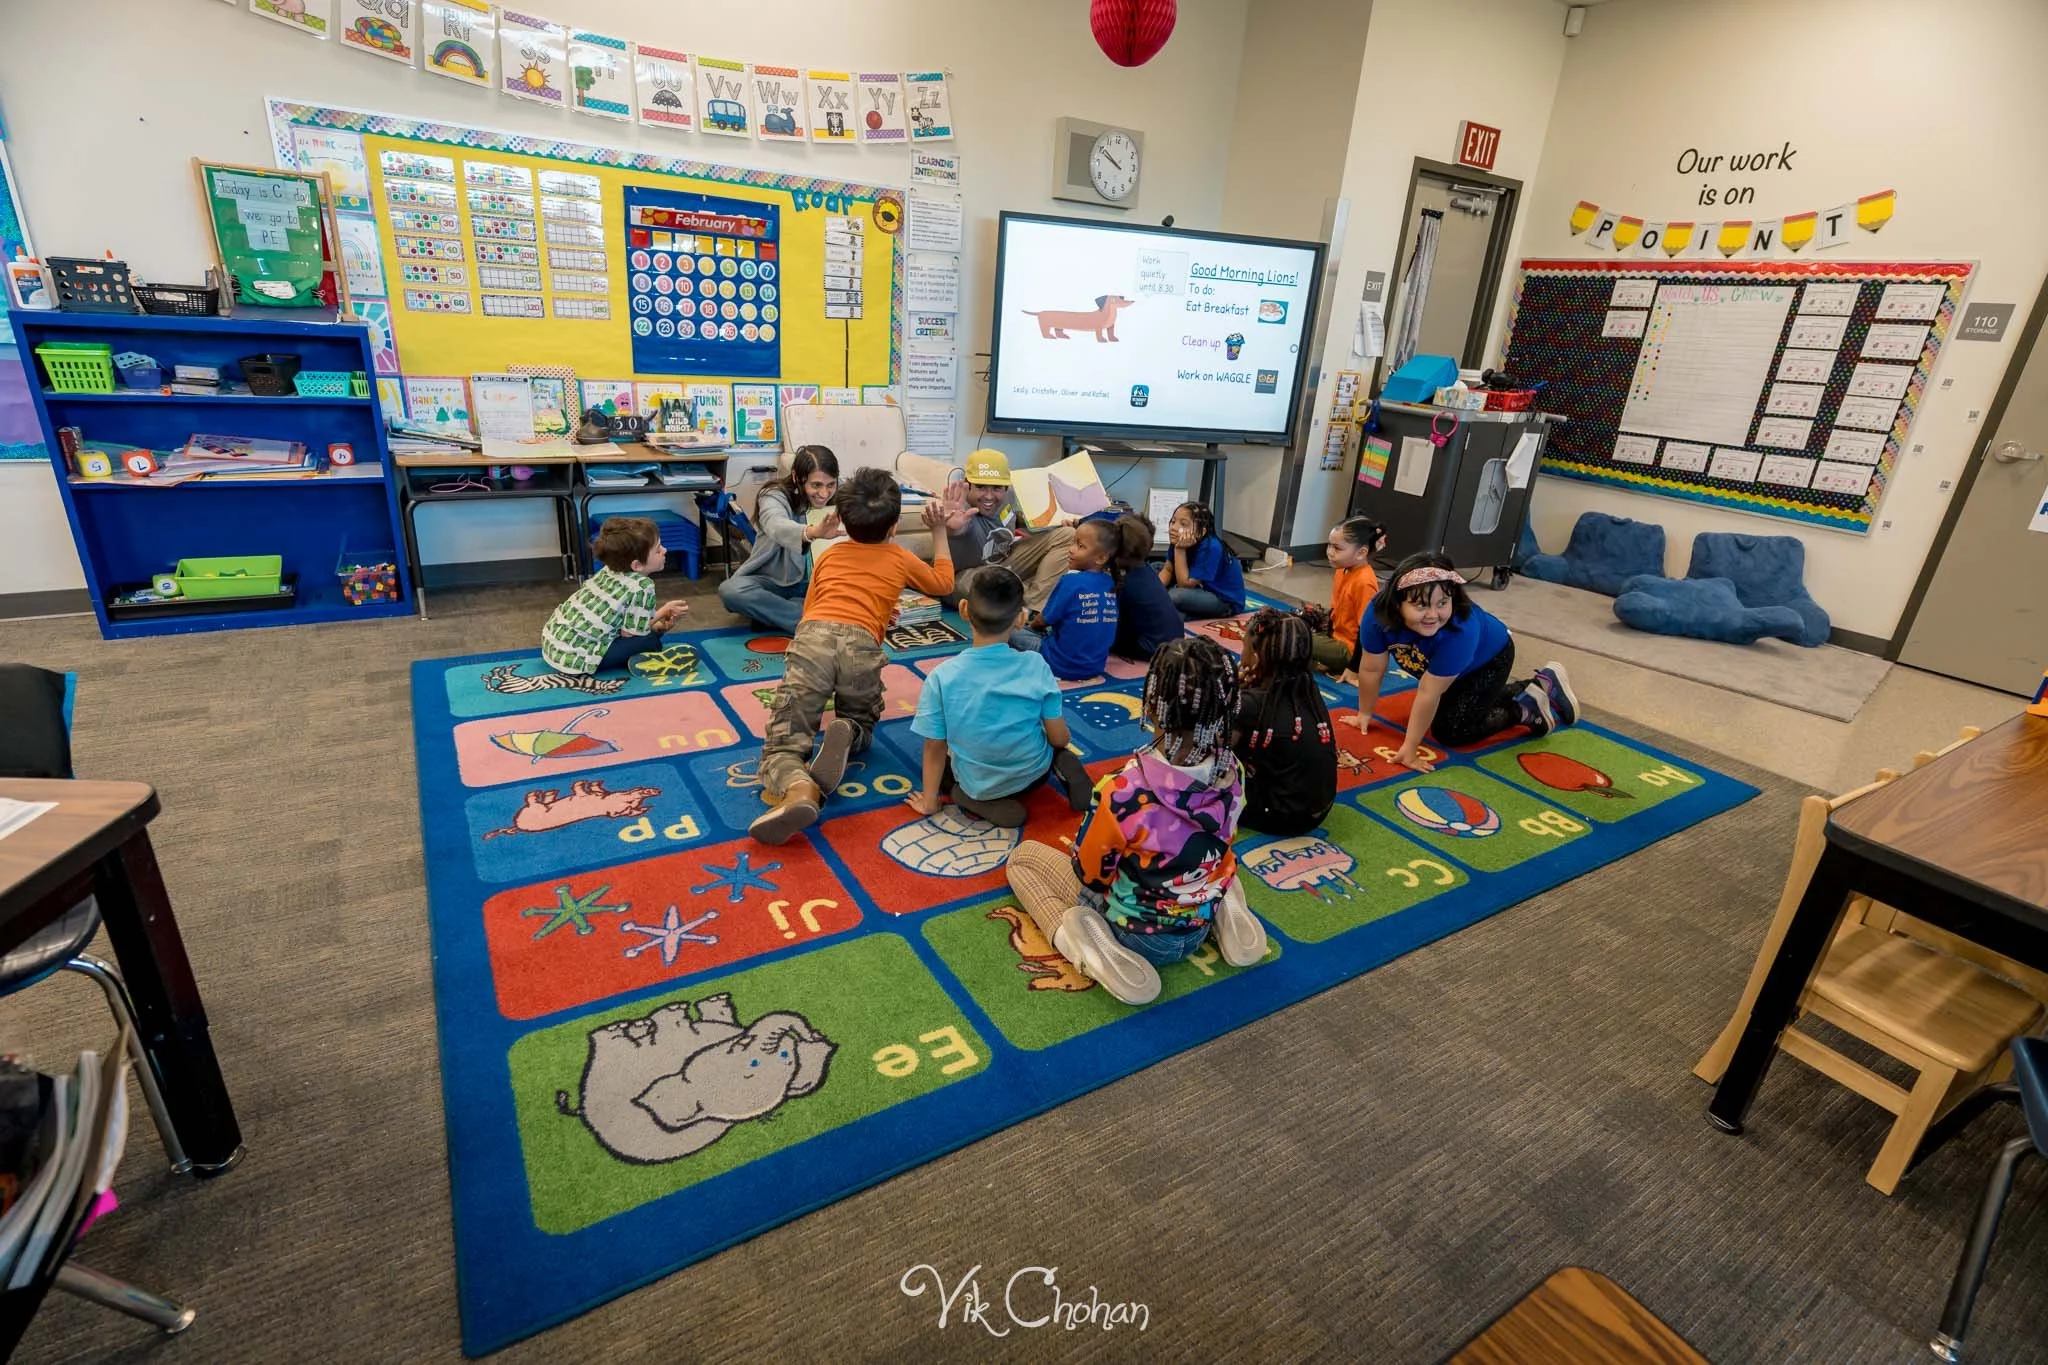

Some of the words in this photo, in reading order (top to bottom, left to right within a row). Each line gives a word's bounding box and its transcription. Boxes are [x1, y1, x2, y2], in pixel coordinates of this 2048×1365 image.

[705, 72, 743, 101] Vv
[757, 80, 799, 106] Ww
[817, 85, 849, 110] Xx
[867, 87, 896, 116] Yy
[917, 86, 942, 109] Zz
[1115, 135, 1122, 145] 12
[1464, 127, 1497, 166] EXIT
[918, 156, 954, 169] LEARNING
[1676, 148, 1724, 175] Our
[1729, 141, 1798, 172] work
[914, 166, 957, 180] INTENTIONS
[217, 179, 250, 200] Today
[259, 189, 268, 198] is
[272, 183, 282, 198] C
[293, 187, 311, 205] day
[1698, 184, 1718, 207] is
[1723, 186, 1755, 205] on
[269, 215, 282, 227] go
[287, 210, 298, 225] to
[675, 213, 736, 233] February
[638, 256, 644, 265] 1
[660, 256, 666, 265] 2
[683, 259, 689, 269] 3
[726, 263, 732, 272] 5
[746, 265, 752, 274] 6
[765, 267, 771, 276] 7
[1142, 255, 1161, 265] Work
[1191, 262, 1217, 277] Good
[1219, 265, 1264, 286] Morning
[1267, 269, 1299, 284] Lions!
[680, 282, 689, 291] 10
[704, 284, 713, 293] 11
[764, 288, 773, 297] 14
[1189, 282, 1200, 294] To
[1202, 283, 1215, 296] do:
[1366, 280, 1382, 291] EXIT
[638, 301, 647, 310] 15
[659, 301, 669, 311] 16
[683, 303, 691, 312] 17
[704, 305, 713, 314] 18
[1186, 300, 1202, 312] Eat
[1204, 302, 1249, 316] Breakfast
[638, 322, 648, 332] 22
[660, 323, 670, 333] 23
[681, 324, 691, 334] 24
[918, 316, 947, 326] SUCCESS
[1965, 327, 1999, 335] STORAGE
[1973, 315, 1999, 328] 110
[915, 328, 949, 337] CRITERIA
[1182, 335, 1208, 348] Clean
[1210, 339, 1222, 351] up
[1177, 369, 1200, 381] Work
[1202, 373, 1213, 381] on
[1216, 372, 1252, 384] WAGGLE
[693, 395, 724, 407] TURNS
[667, 417, 689, 425] WILD
[657, 728, 734, 749] Uu
[836, 774, 913, 797] Oo
[1637, 764, 1696, 788] Aa
[618, 814, 701, 843] Pp
[1517, 810, 1585, 838] Bb
[1386, 859, 1455, 888] Cc
[767, 897, 839, 940] Jj
[873, 1025, 979, 1078] Ee
